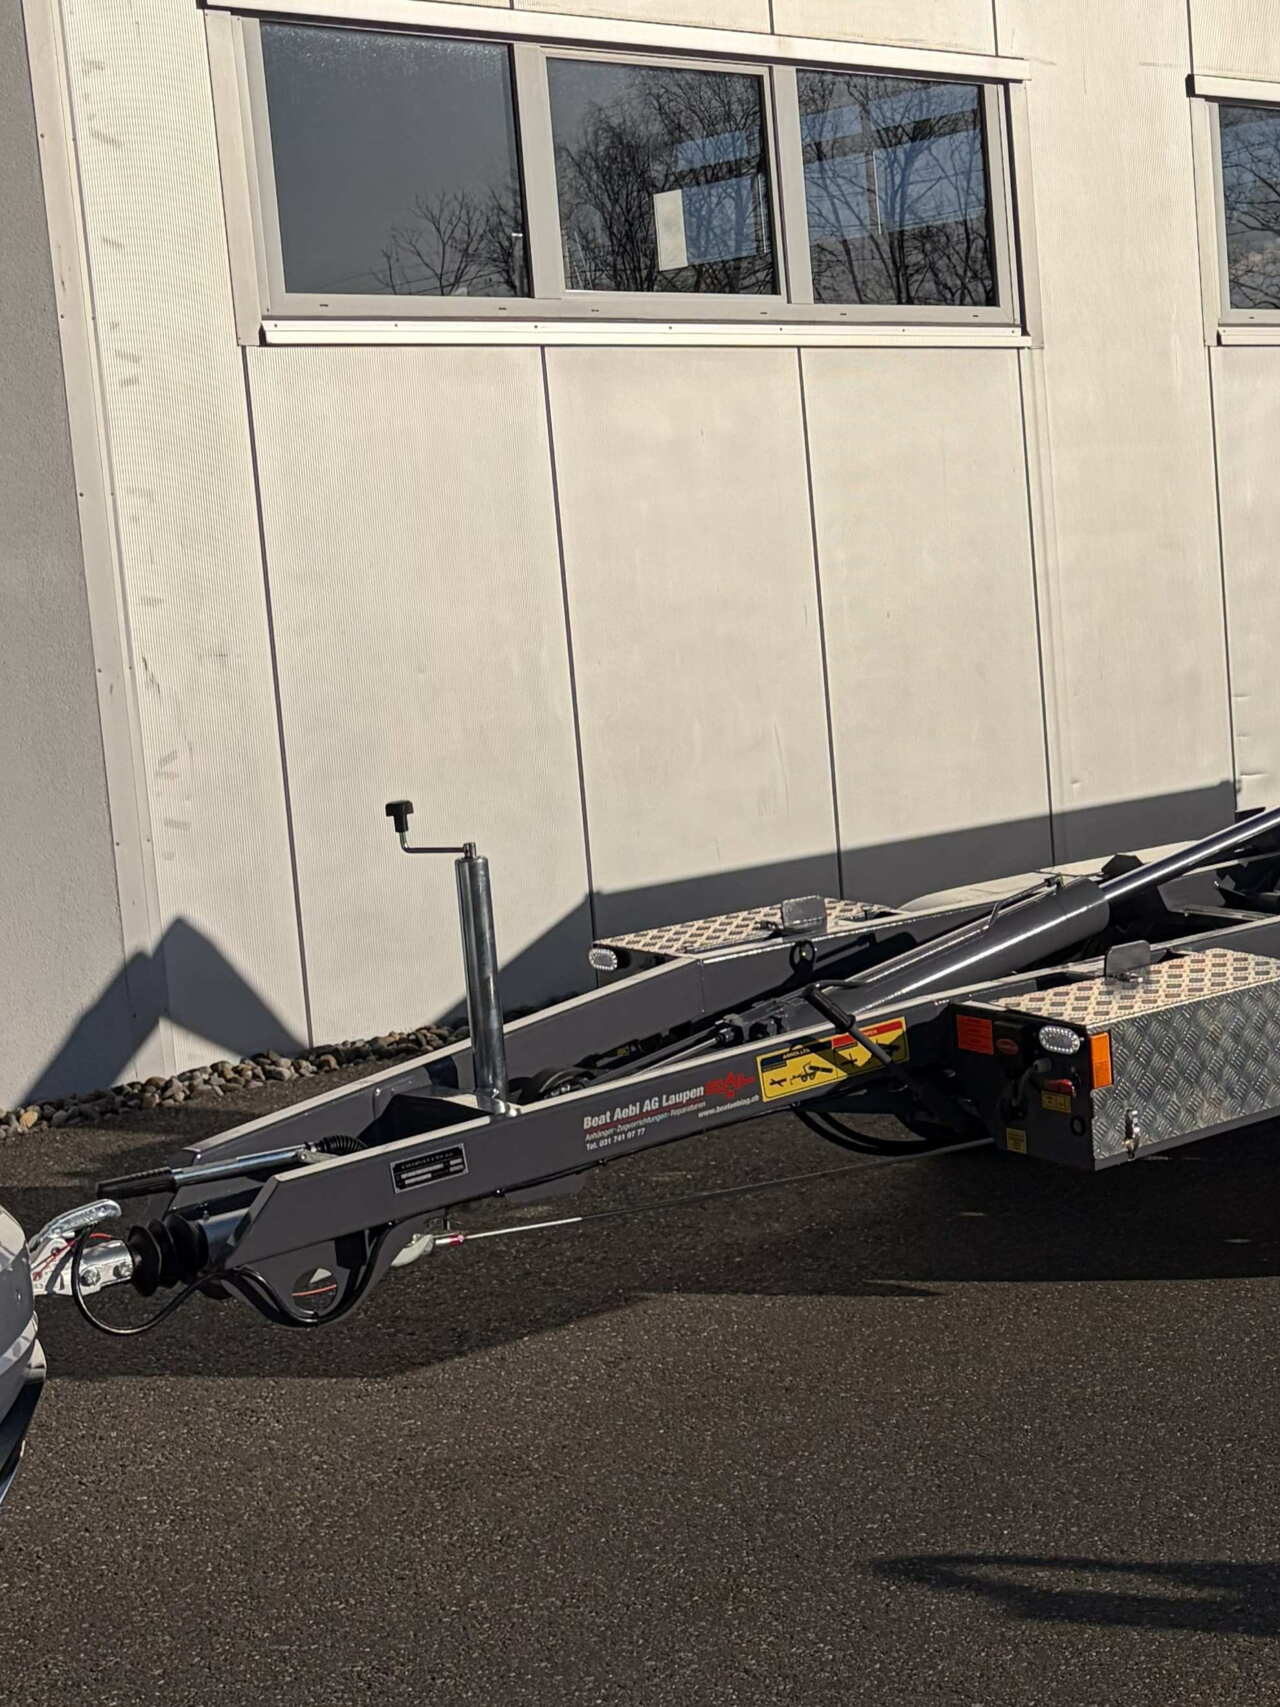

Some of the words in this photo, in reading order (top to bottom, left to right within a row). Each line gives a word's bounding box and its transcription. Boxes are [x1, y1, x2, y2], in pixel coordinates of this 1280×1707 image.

[583, 1111, 611, 1130] Beat
[613, 1102, 640, 1121] Aebi
[642, 1096, 659, 1113] AG
[662, 1086, 704, 1107] Laupen
[586, 1142, 598, 1151] Tel.
